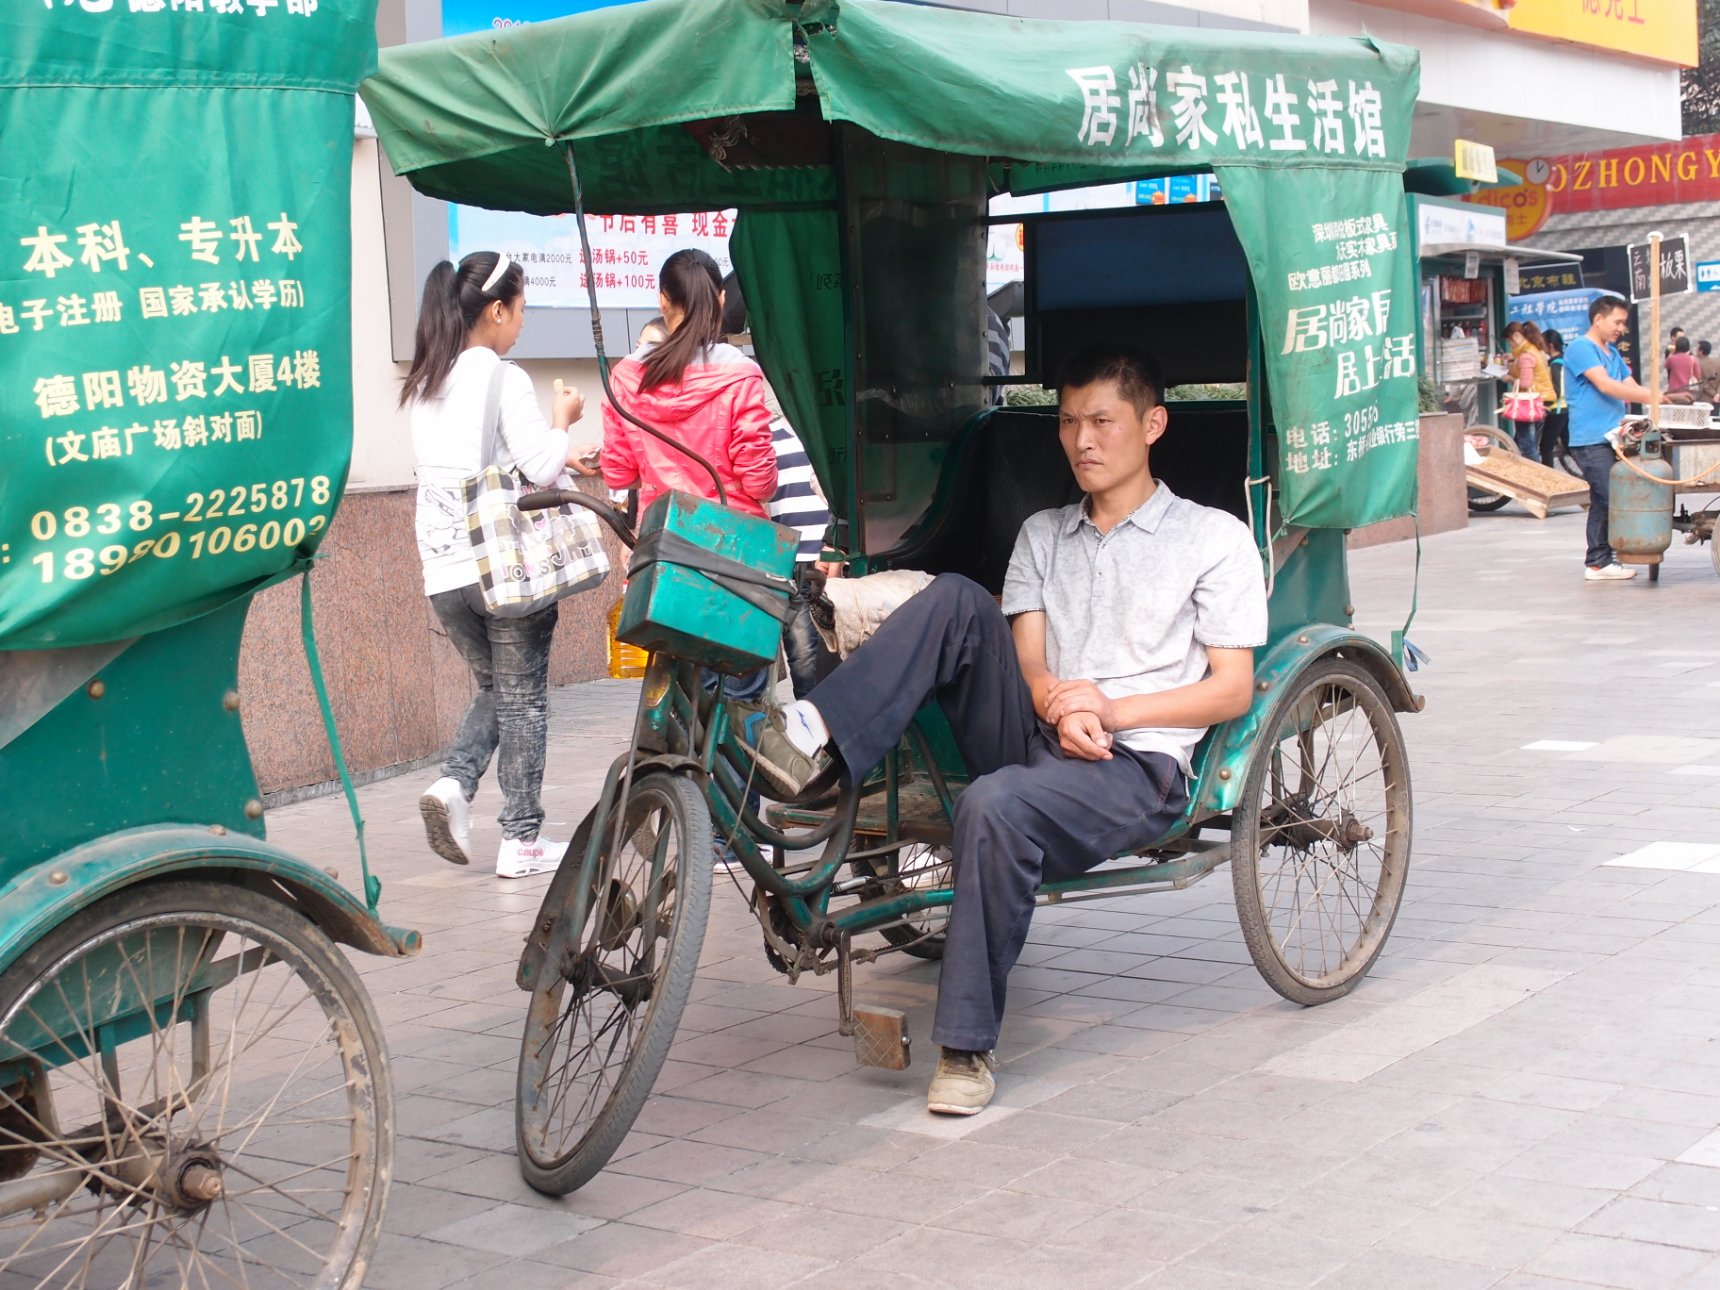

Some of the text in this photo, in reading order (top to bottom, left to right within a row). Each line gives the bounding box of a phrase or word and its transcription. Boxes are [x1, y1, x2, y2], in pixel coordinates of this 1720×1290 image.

[1065, 62, 1386, 158] 居尚家私生活馆
[692, 211, 736, 238] 现金
[33, 349, 321, 419] 德阳物资大厦4楼
[31, 475, 331, 540] 0838-2225878
